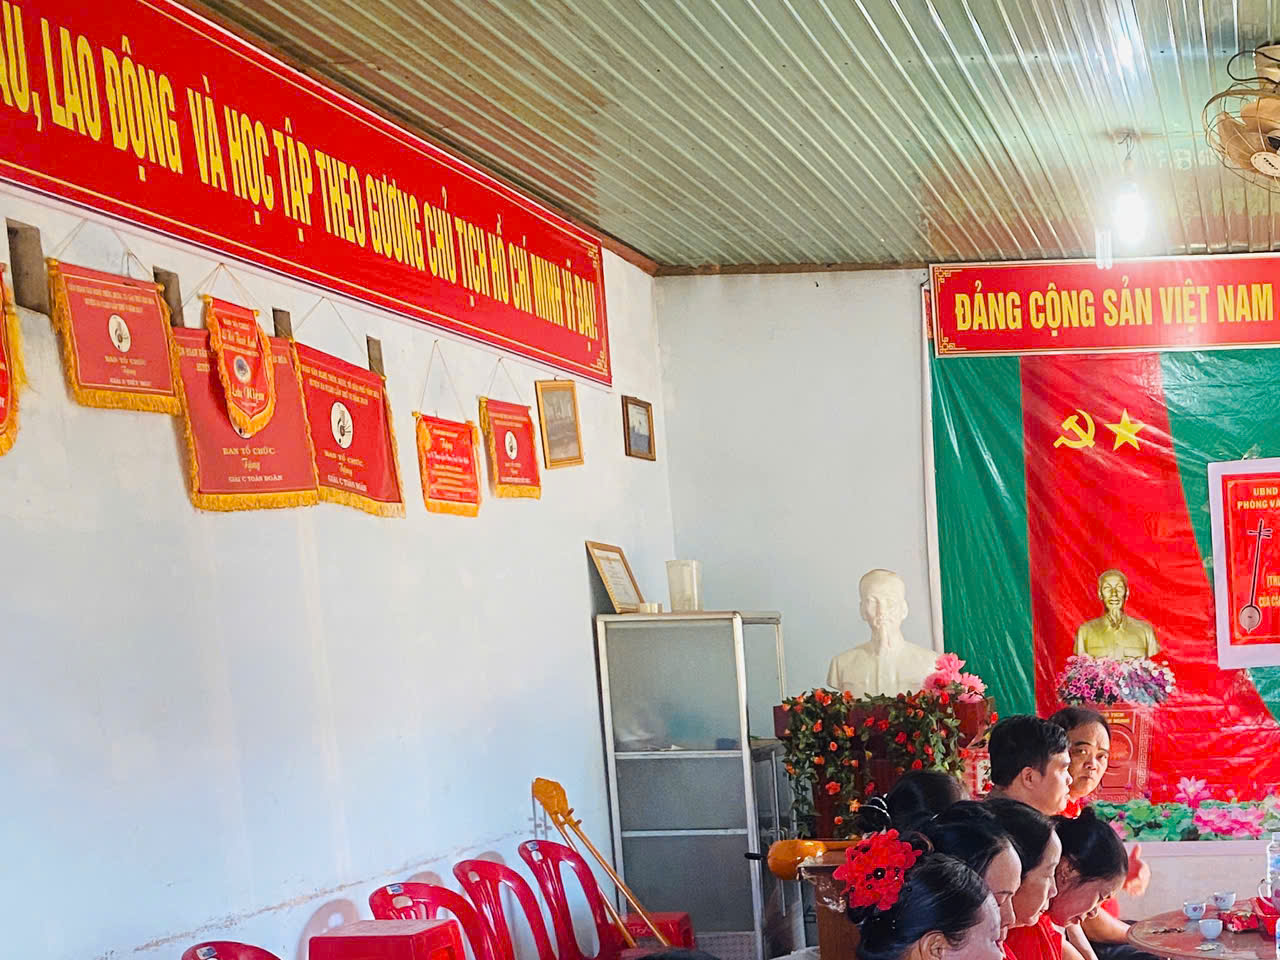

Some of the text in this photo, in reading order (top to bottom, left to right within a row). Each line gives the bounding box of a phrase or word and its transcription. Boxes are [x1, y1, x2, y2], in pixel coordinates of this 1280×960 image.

[41, 17, 101, 141] LAO
[101, 35, 183, 182] ĐỘNG
[186, 74, 228, 192] VÀ
[223, 104, 274, 225] HỌC
[272, 116, 313, 242] TẬP
[314, 149, 366, 248] THEO
[365, 173, 426, 271] GƯƠNG
[424, 186, 456, 284] CHỦ
[454, 216, 490, 307] TỊCH
[488, 213, 509, 304] HỒ
[508, 235, 533, 314] CHÍ
[530, 253, 564, 327] MINH
[562, 258, 576, 332] VĨ
[574, 274, 599, 352] ĐẠI!
[954, 280, 1022, 331] ĐẢNG
[1029, 282, 1096, 337] CỘNG
[1103, 276, 1153, 327] SẢN
[1159, 278, 1209, 333] VIỆT
[1217, 283, 1274, 323] NAM
[1237, 498, 1268, 510] PHÒNG
[1253, 487, 1278, 497] UBND
